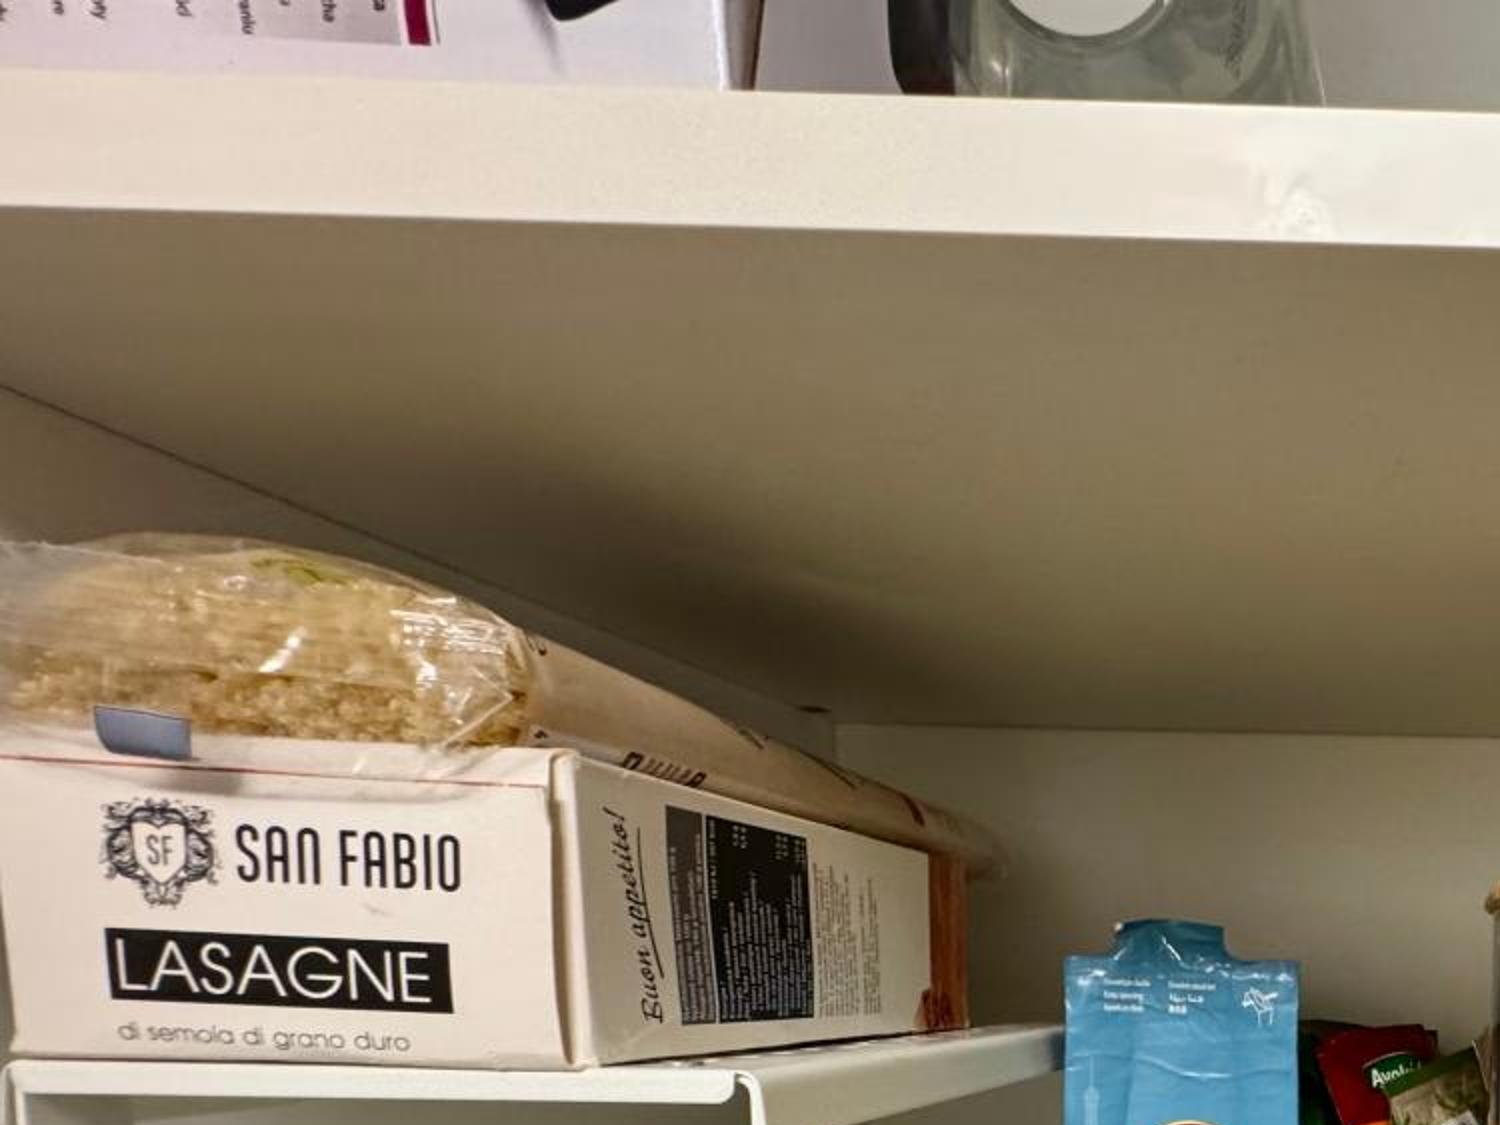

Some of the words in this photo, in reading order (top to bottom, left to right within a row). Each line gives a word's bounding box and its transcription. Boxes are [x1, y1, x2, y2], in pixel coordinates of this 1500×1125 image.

[145, 833, 173, 866] SF
[235, 823, 321, 885] SAN
[338, 829, 461, 893] FABIO
[602, 805, 653, 938] appetito!
[115, 938, 432, 1004] LASAGNE
[641, 948, 664, 1024] Buon
[118, 1022, 140, 1042] di
[150, 1024, 234, 1045] semola
[243, 1028, 265, 1047] di
[273, 1031, 346, 1051] grano
[353, 1032, 411, 1052] duro
